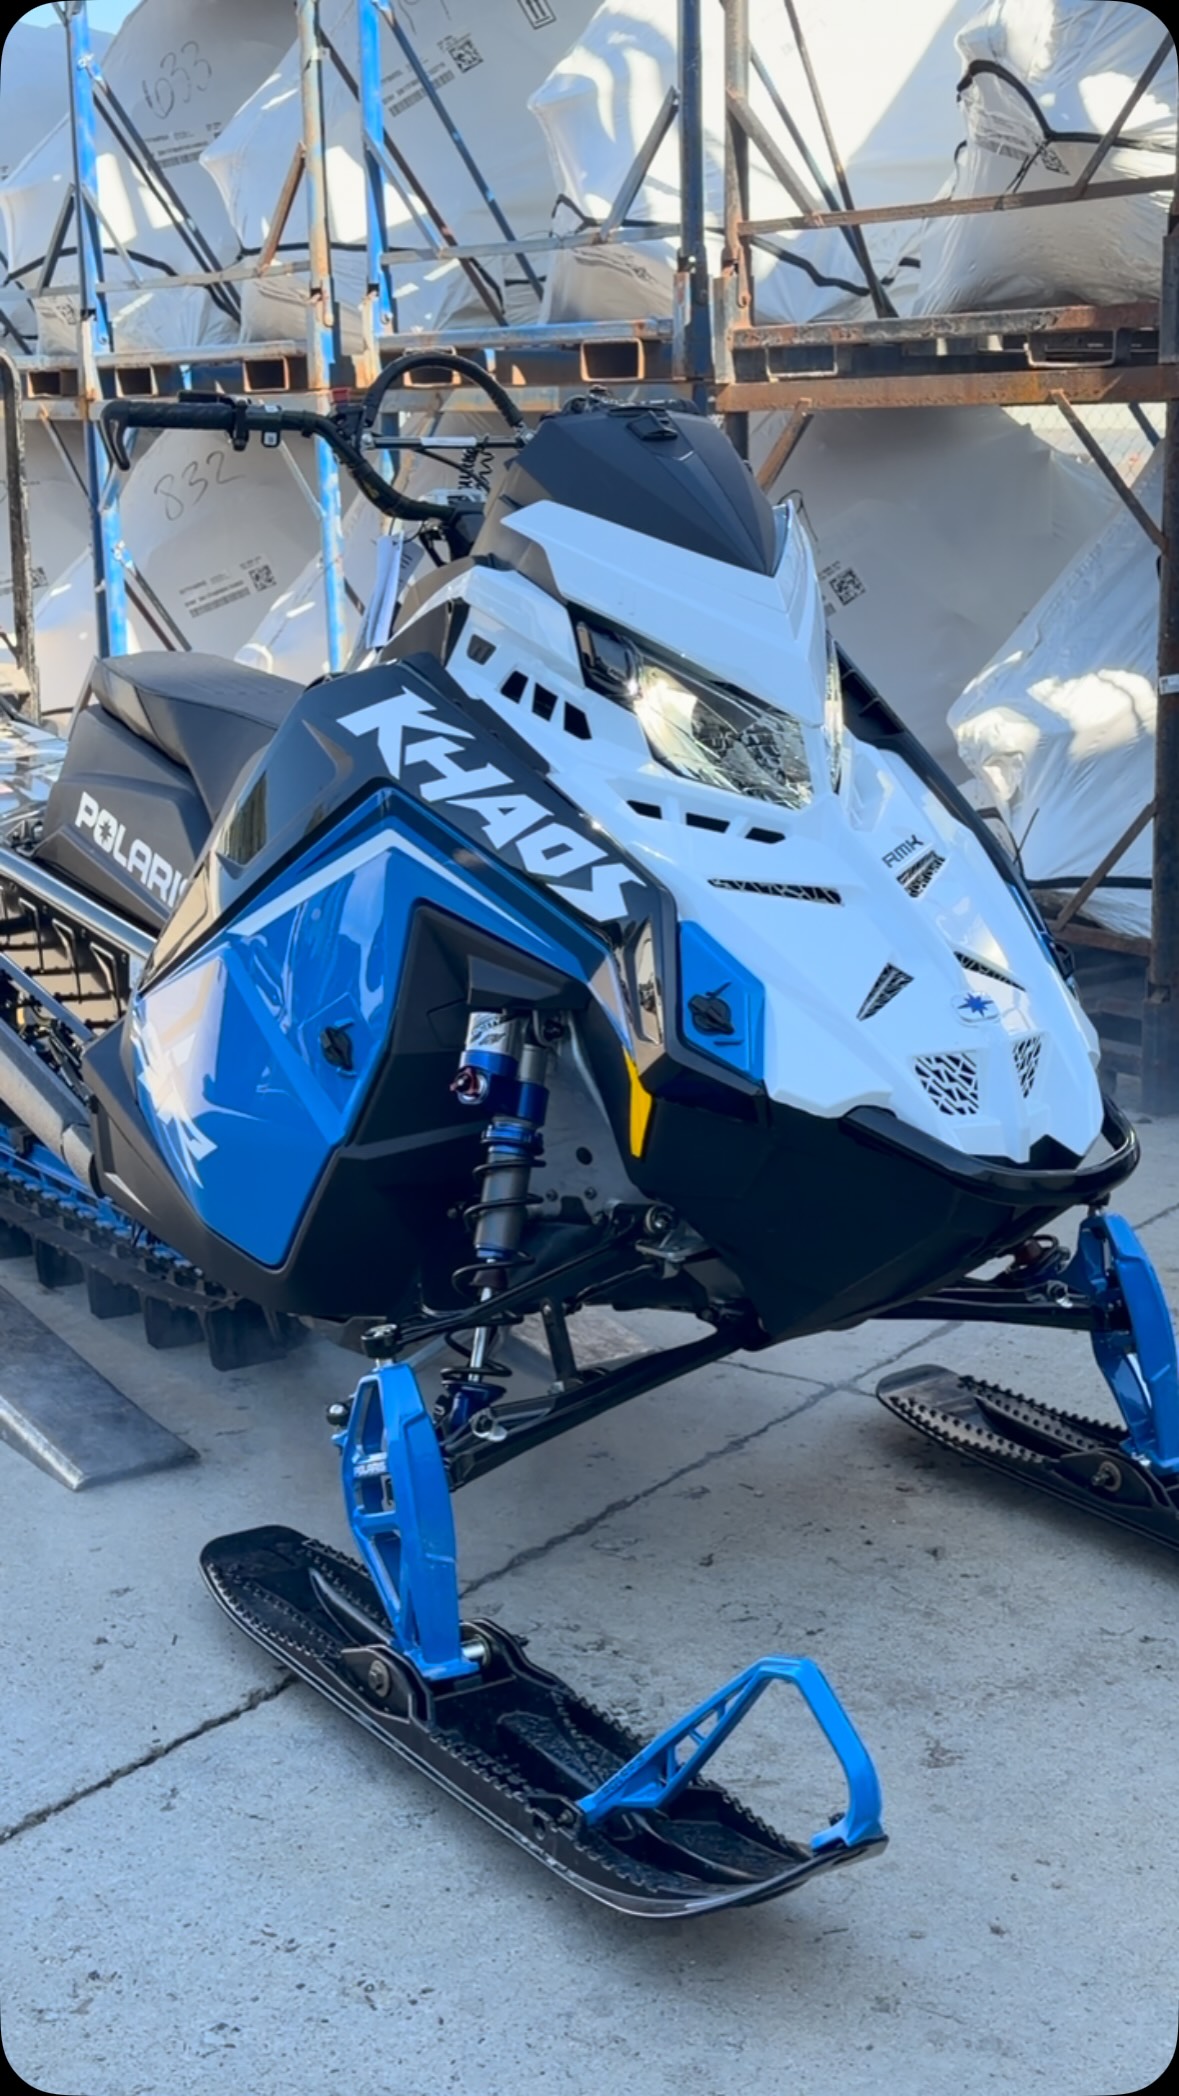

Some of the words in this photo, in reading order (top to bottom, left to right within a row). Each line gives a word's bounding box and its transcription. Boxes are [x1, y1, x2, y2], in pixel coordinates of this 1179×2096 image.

[153, 450, 247, 521] 832
[74, 791, 189, 908] POLARI
[335, 685, 647, 922] KHAOS
[881, 834, 924, 868] RMK
